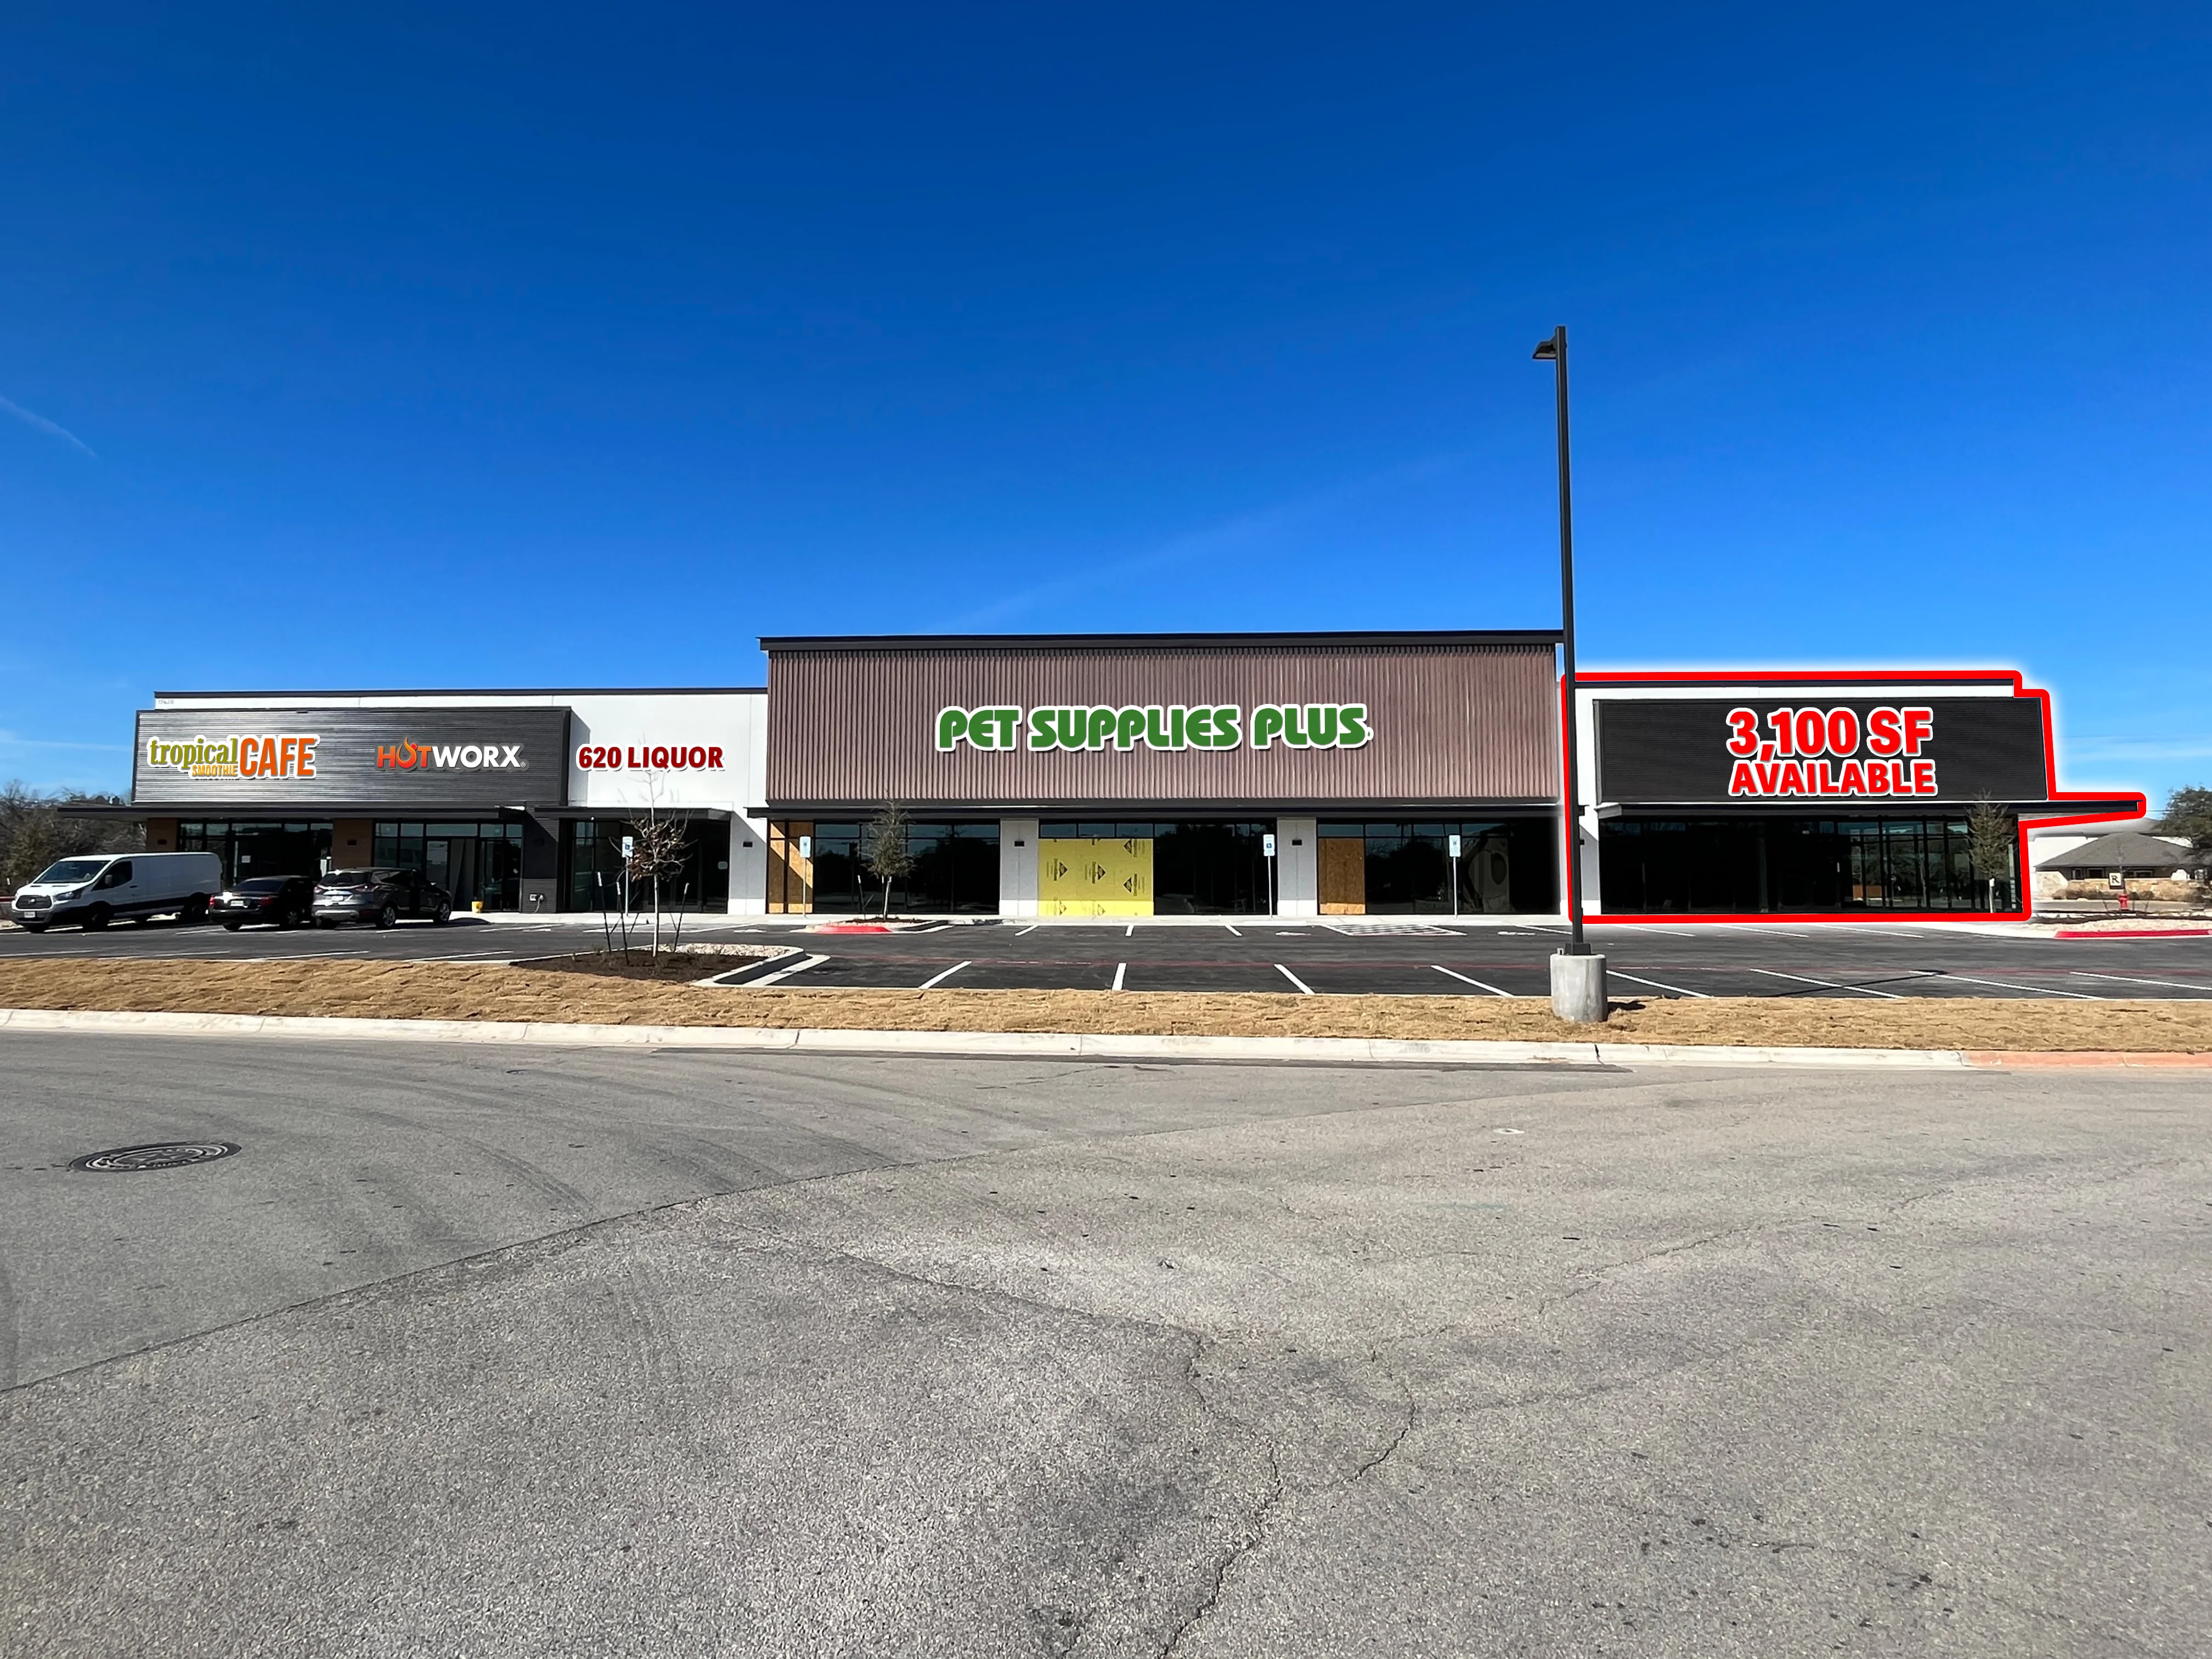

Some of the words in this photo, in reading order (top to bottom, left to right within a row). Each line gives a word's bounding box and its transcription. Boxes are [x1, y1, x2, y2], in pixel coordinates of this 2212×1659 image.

[939, 709, 1019, 748] PET
[1031, 709, 1239, 747] SUPPLIES
[1254, 707, 1365, 746] PLUS
[150, 738, 239, 769] tropical
[240, 738, 315, 776] CAFE
[192, 765, 238, 776] SMOOTHIE
[579, 747, 622, 768] 620
[628, 747, 724, 769] LIQUOR
